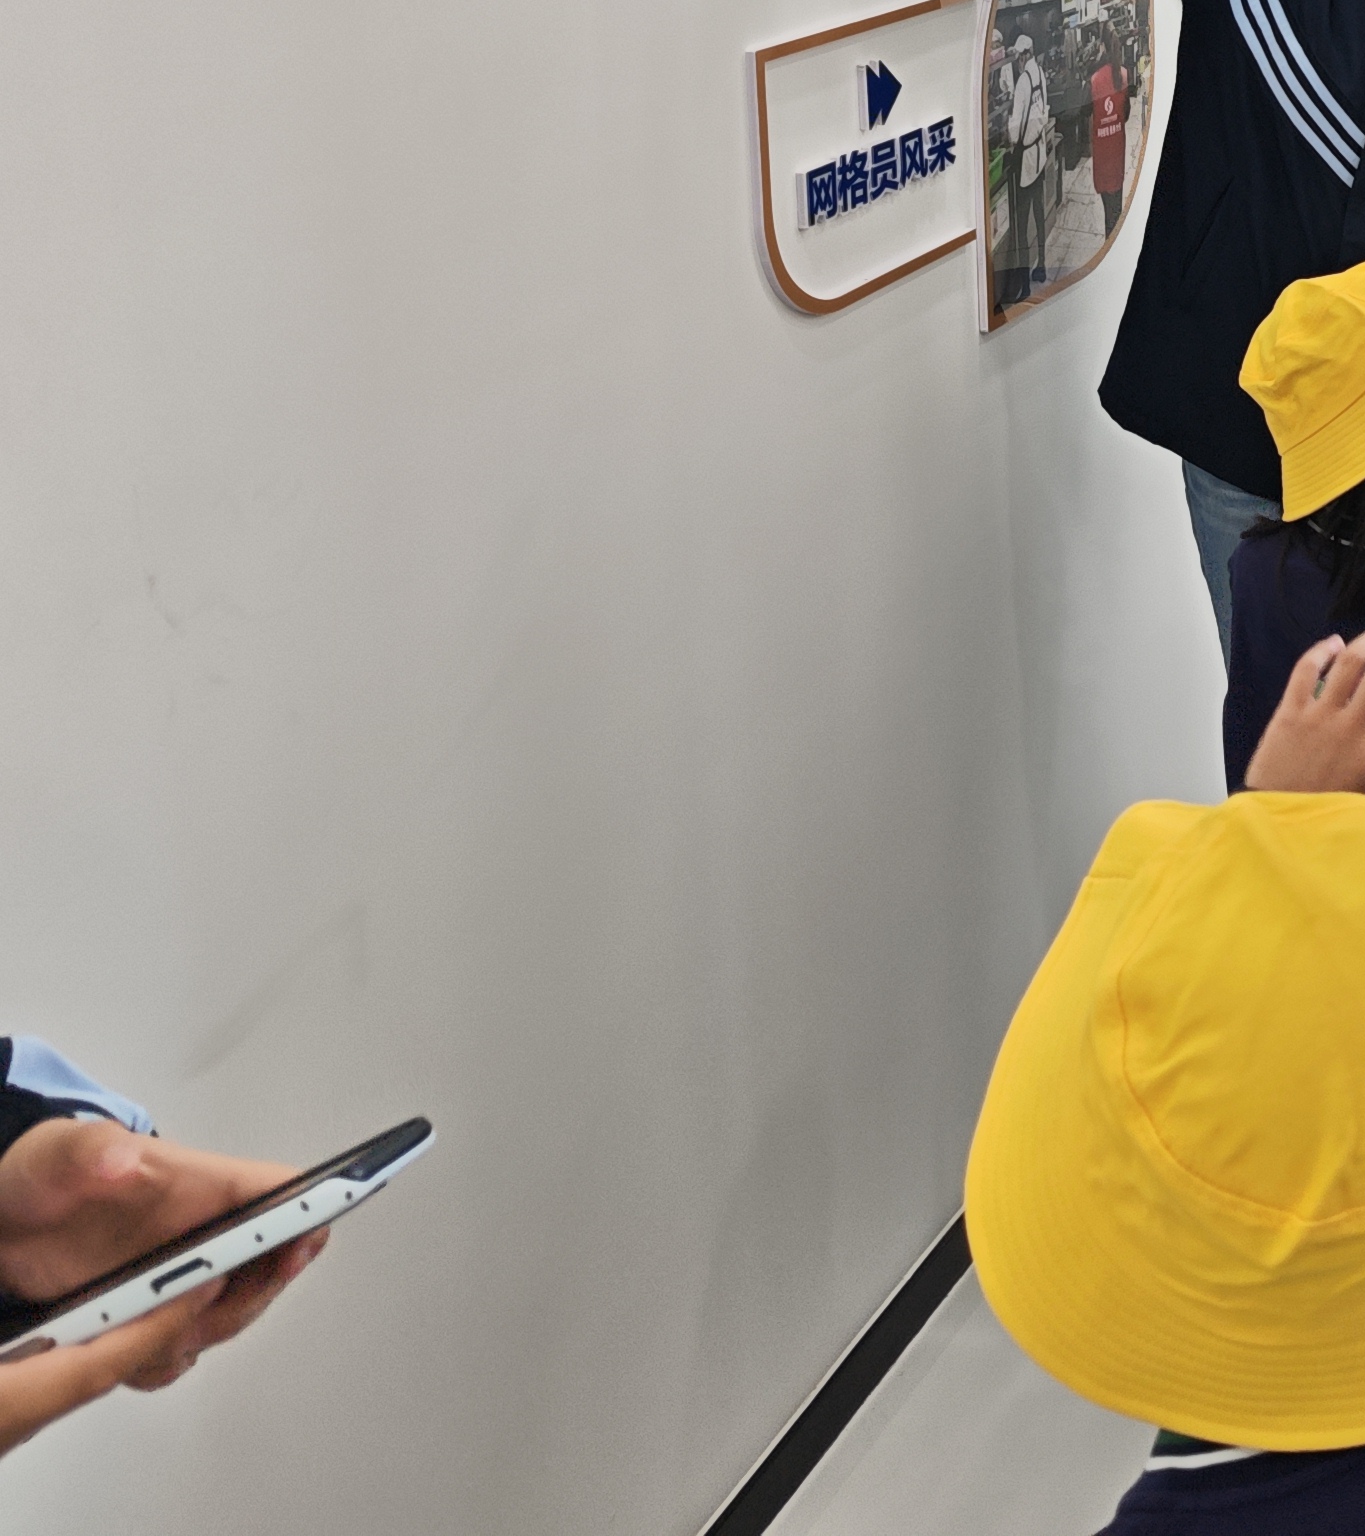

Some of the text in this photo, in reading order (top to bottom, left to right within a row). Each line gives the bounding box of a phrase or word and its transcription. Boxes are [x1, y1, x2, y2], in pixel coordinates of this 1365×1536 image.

[805, 117, 956, 226] 网格员风采
